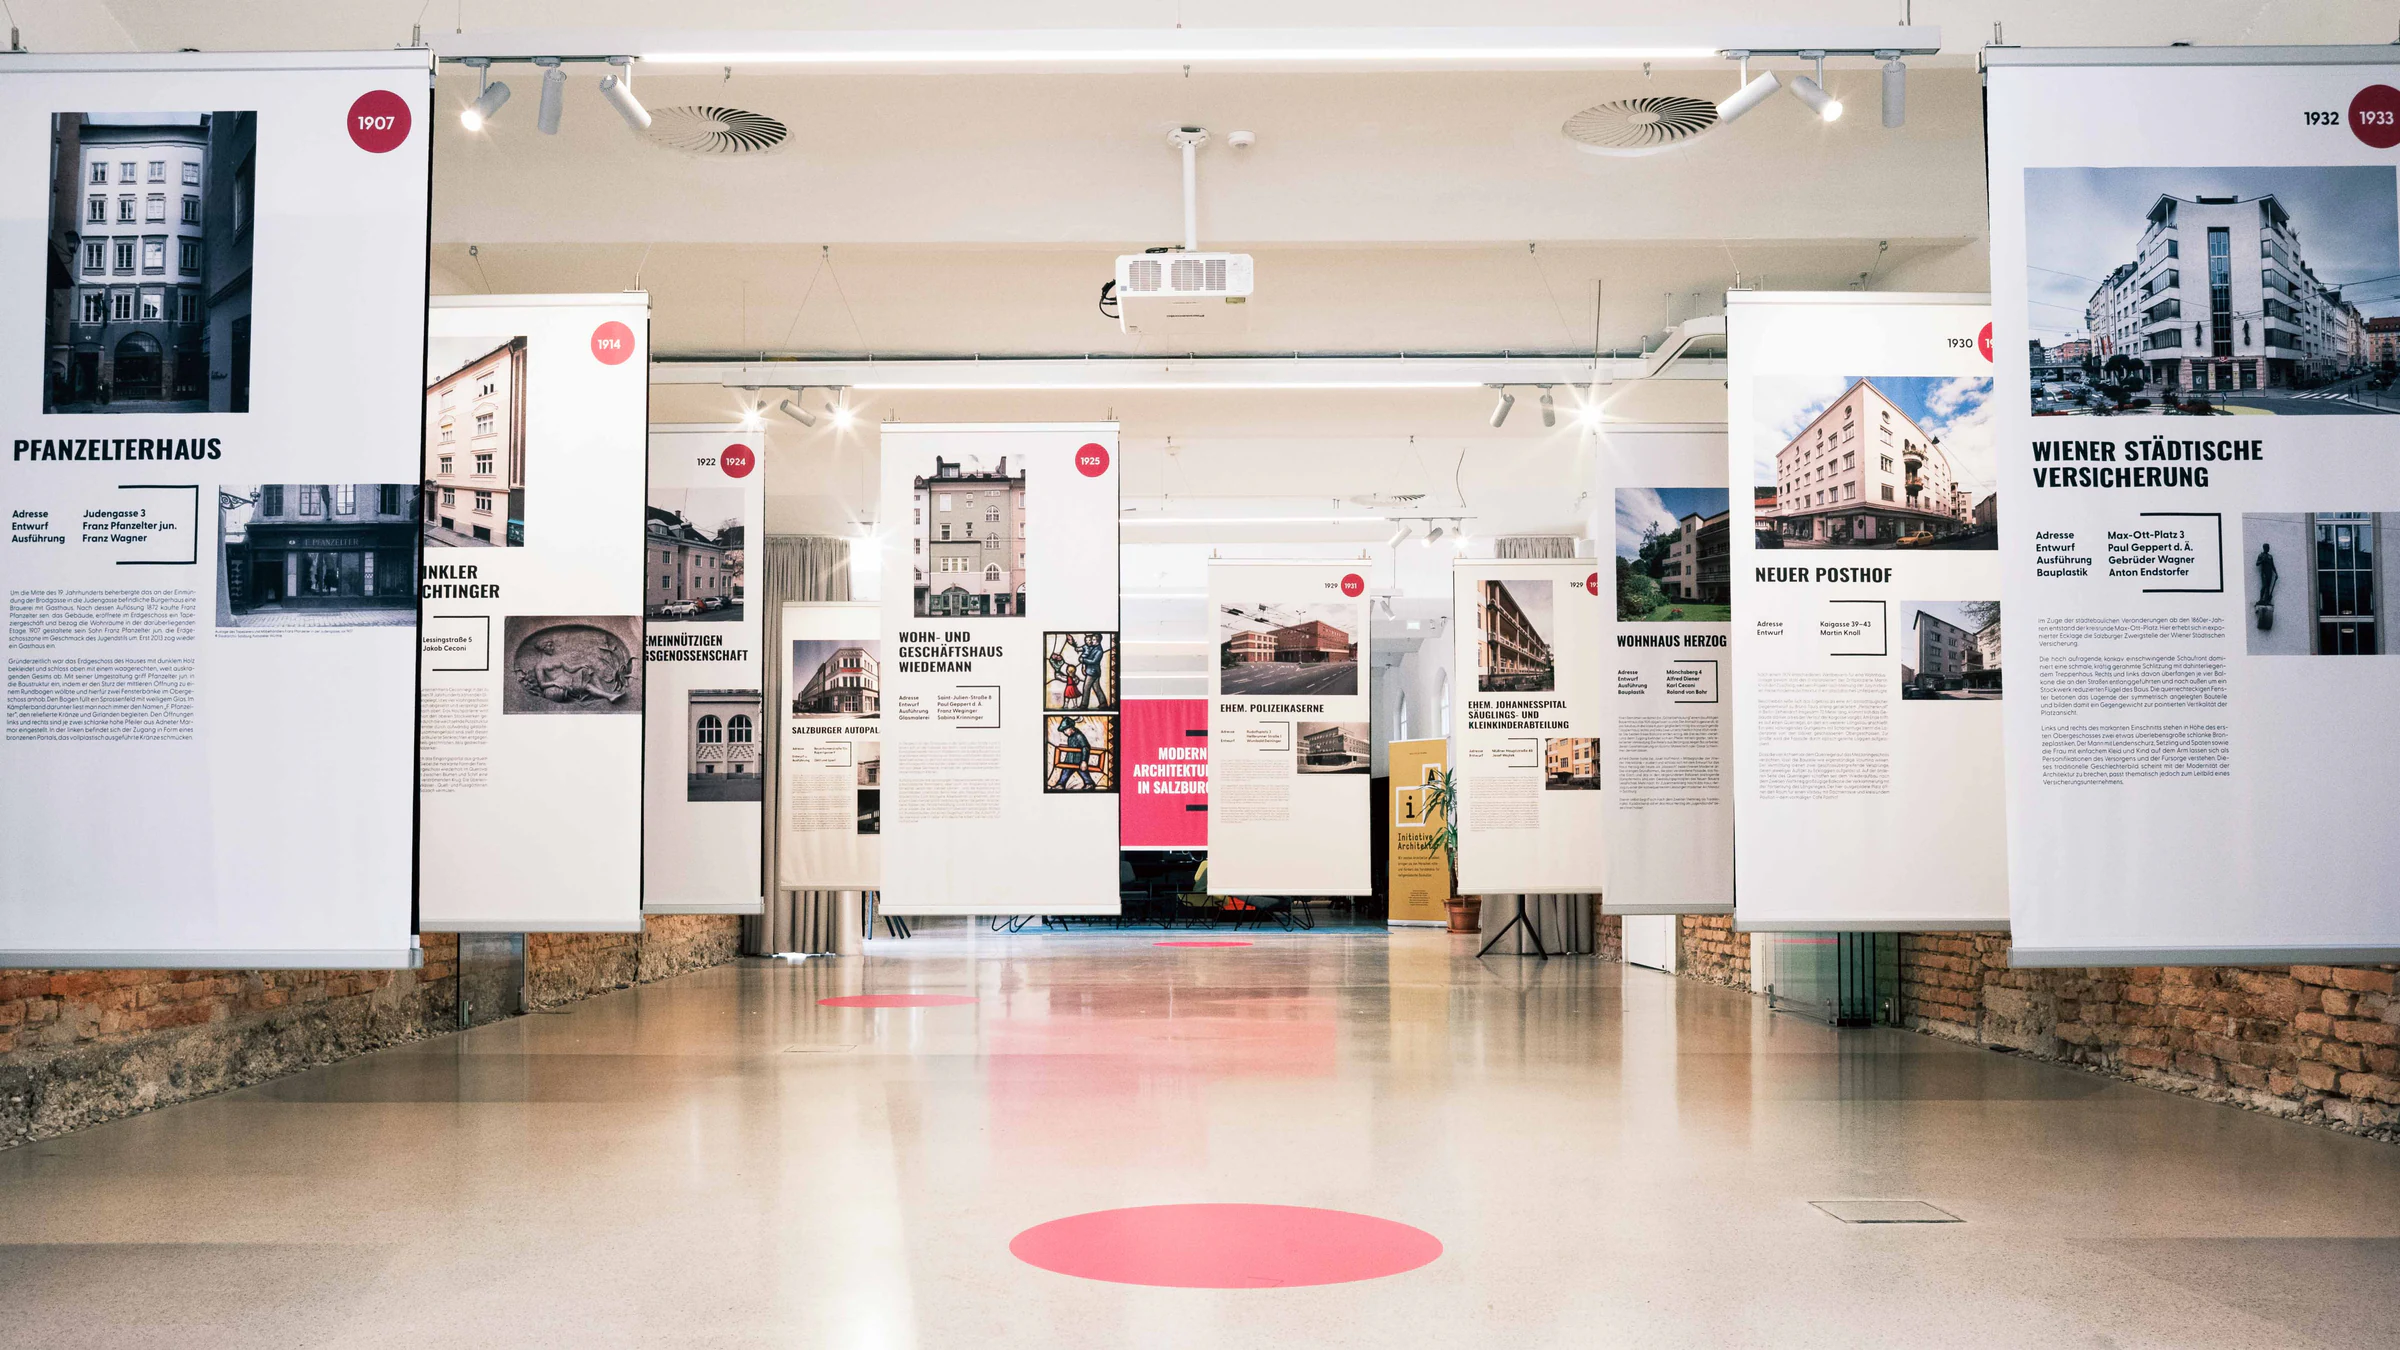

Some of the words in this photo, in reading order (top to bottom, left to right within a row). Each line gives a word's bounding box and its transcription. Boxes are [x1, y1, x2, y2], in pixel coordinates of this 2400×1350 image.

[358, 116, 395, 130] 1907
[2304, 112, 2339, 125] 1932
[2359, 111, 2394, 124] 1933
[598, 339, 621, 349] 1914
[1947, 338, 1973, 349] 1930
[14, 438, 221, 461] PFANZELTERHAUS
[2032, 441, 2116, 461] WIENER
[2125, 435, 2263, 461] STÄDTISCHE
[697, 457, 716, 467] 1922
[726, 457, 746, 466] 1924
[1081, 456, 1100, 466] 1925
[2033, 467, 2208, 488] VERSICHERUNG
[12, 509, 48, 519] Adresse
[83, 509, 139, 521] Judengasse
[141, 508, 145, 518] 3
[12, 521, 48, 531] Entwurf
[83, 521, 108, 531] Franz
[111, 521, 160, 531] Pfanzelter
[159, 521, 177, 531] jun.
[12, 534, 65, 544] Ausführung
[83, 533, 108, 543] Franz
[111, 534, 147, 544] Wagner
[2036, 530, 2074, 540] Adresse
[2108, 529, 2177, 540] Max-Ott-Platz
[2180, 530, 2184, 539] 3
[2036, 542, 2075, 553] Entwurf
[2108, 542, 2128, 553] Paul
[2131, 543, 2172, 554] Geppert
[2174, 542, 2182, 552] d.
[2184, 541, 2193, 551] Ä.
[2037, 556, 2092, 566] Ausführung
[2109, 554, 2155, 565] Gebrüder
[2158, 555, 2195, 566] Wagner
[1756, 567, 1809, 582] NEUER
[1816, 568, 1892, 583] POSTHOF
[2037, 568, 2087, 578] Bauplastik
[2109, 568, 2138, 577] Anton
[2141, 566, 2189, 577] Endstorfer
[422, 584, 500, 598] CHTINGER
[1820, 620, 1850, 629] Kaigasse
[423, 636, 467, 645] Lessingstraße
[646, 632, 722, 646] EMEINNÜTZIGEN
[899, 631, 940, 643] WOHN-
[945, 631, 970, 643] UND
[1617, 635, 1680, 647] WOHNHAUS
[1684, 635, 1727, 647] HERZOG
[899, 644, 1003, 657] GESCHÄFTSHAUS
[899, 661, 971, 672] WIEDEMANN
[1666, 668, 1698, 678] Mönchsberg
[1221, 703, 1247, 713] EHEM.
[1250, 703, 1324, 713] POLIZEIKASERNE
[1468, 700, 1494, 709] EHEM.
[1496, 700, 1567, 709] JOHANNESSPITAL
[1469, 709, 1518, 719] SÄUGLINGS-
[1522, 710, 1539, 720] UND
[1469, 720, 1569, 730] KLEINKINDERABTEILUNG
[792, 726, 842, 735] SALZBURGER
[845, 726, 880, 736] AUTOPAL
[1158, 747, 1208, 760] MODERN
[1138, 781, 1150, 794] IN
[1398, 832, 1433, 842] Initiative
